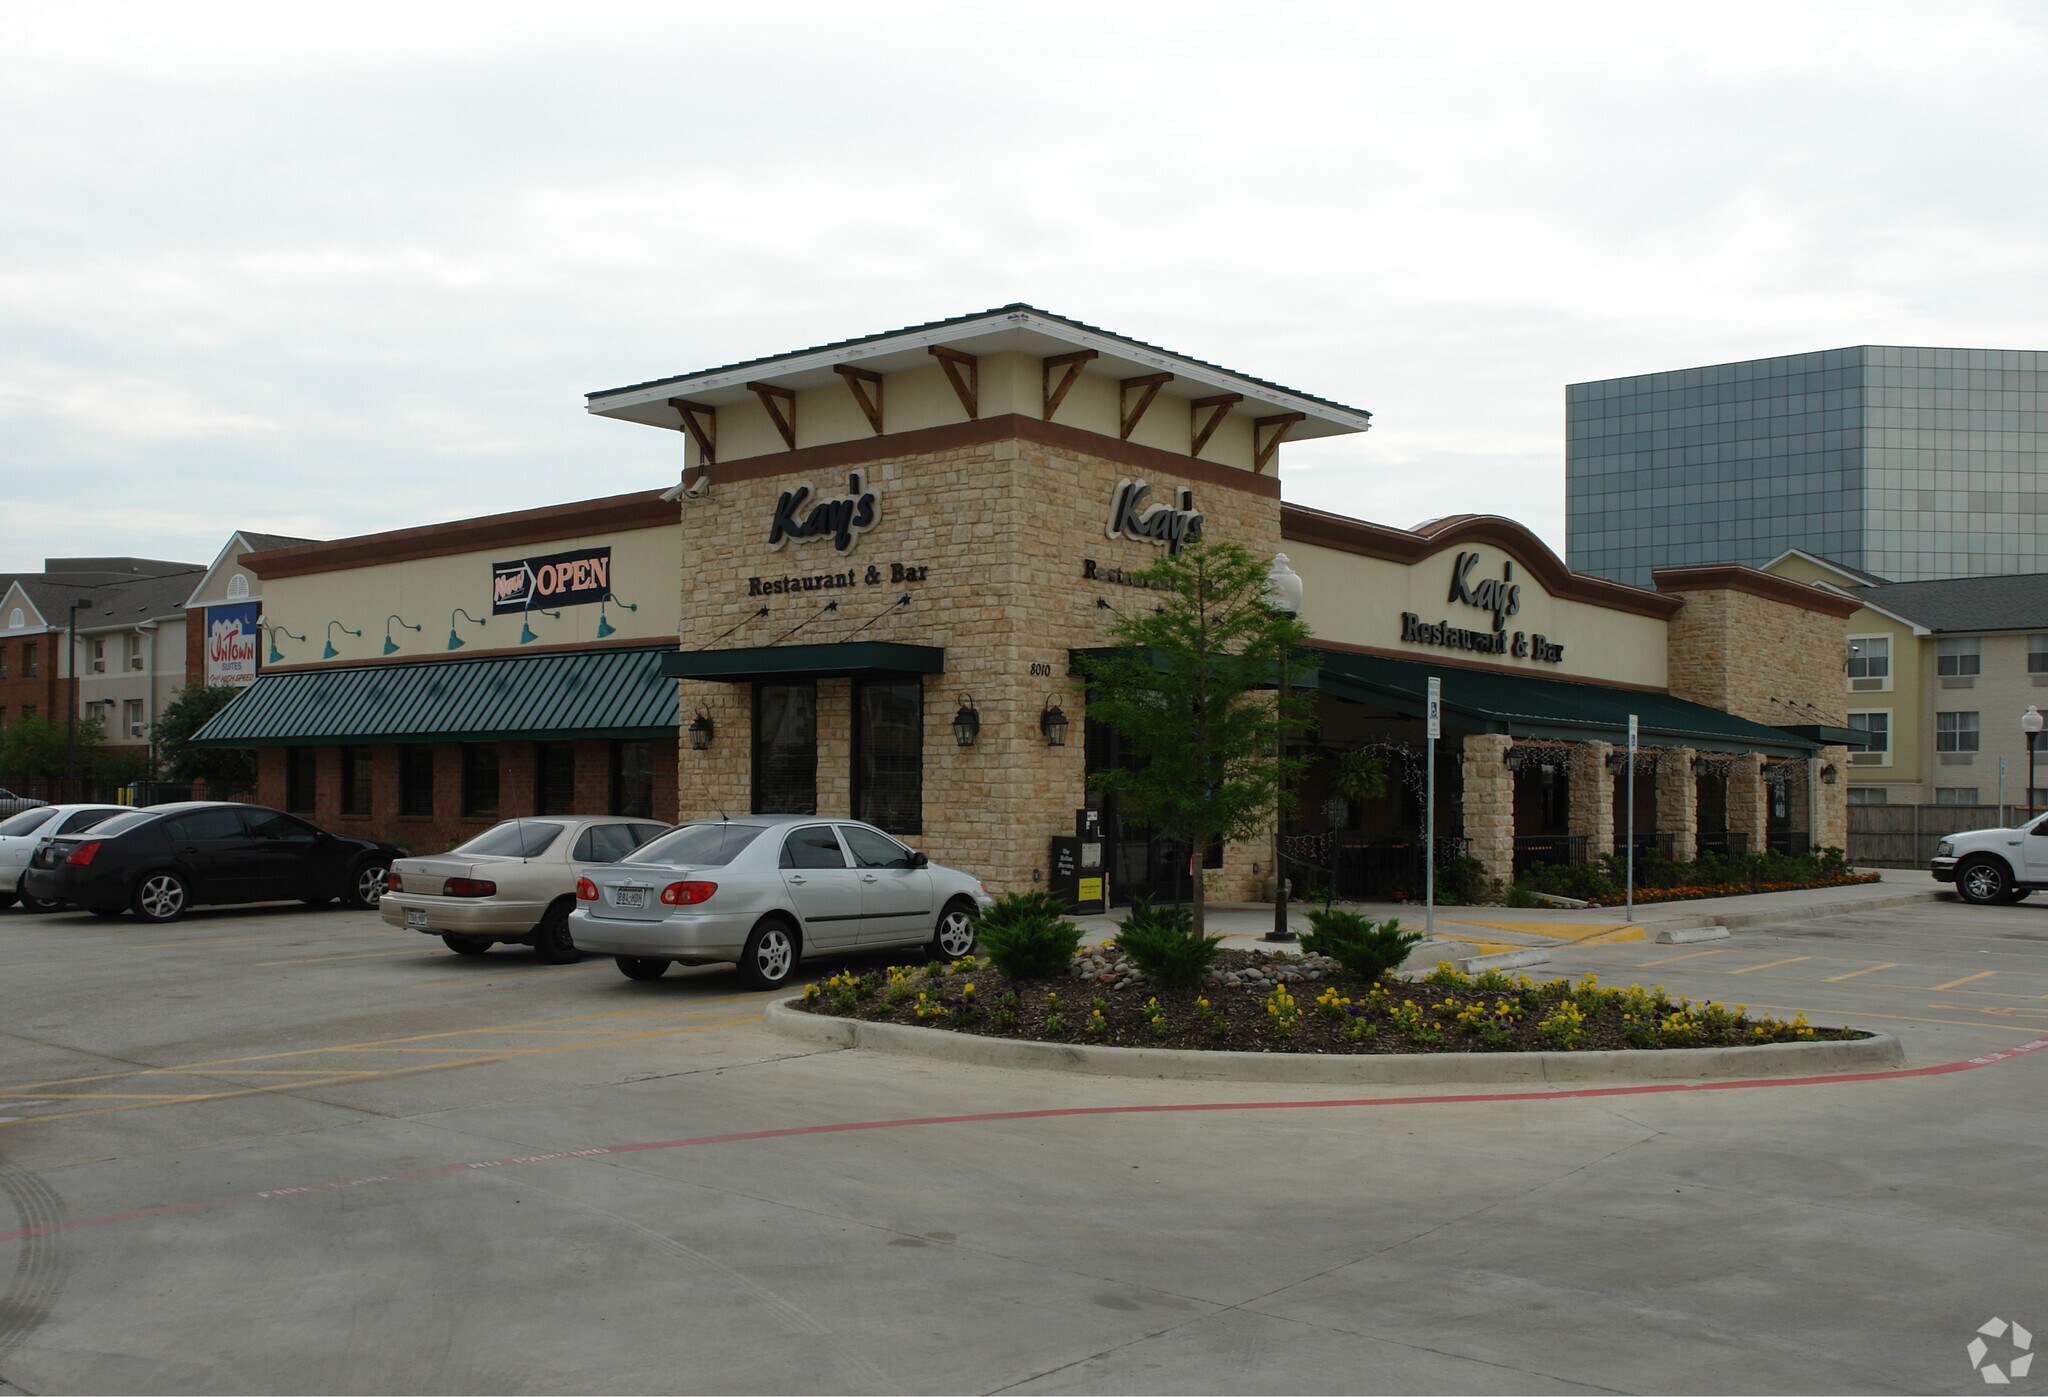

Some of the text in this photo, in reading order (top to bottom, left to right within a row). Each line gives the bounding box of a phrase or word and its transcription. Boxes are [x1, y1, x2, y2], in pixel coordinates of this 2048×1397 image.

[769, 474, 874, 551] Kay's
[1113, 483, 1204, 556] Kay's
[494, 570, 525, 602] Now
[537, 557, 609, 596] OPEN
[749, 562, 928, 596] Restaurant & Bar
[1449, 551, 1521, 632] Kay's
[1401, 612, 1564, 662] Restaurant & Bar
[222, 662, 241, 671] SUITES
[236, 673, 254, 681] SPEED
[1030, 663, 1051, 677] 8010
